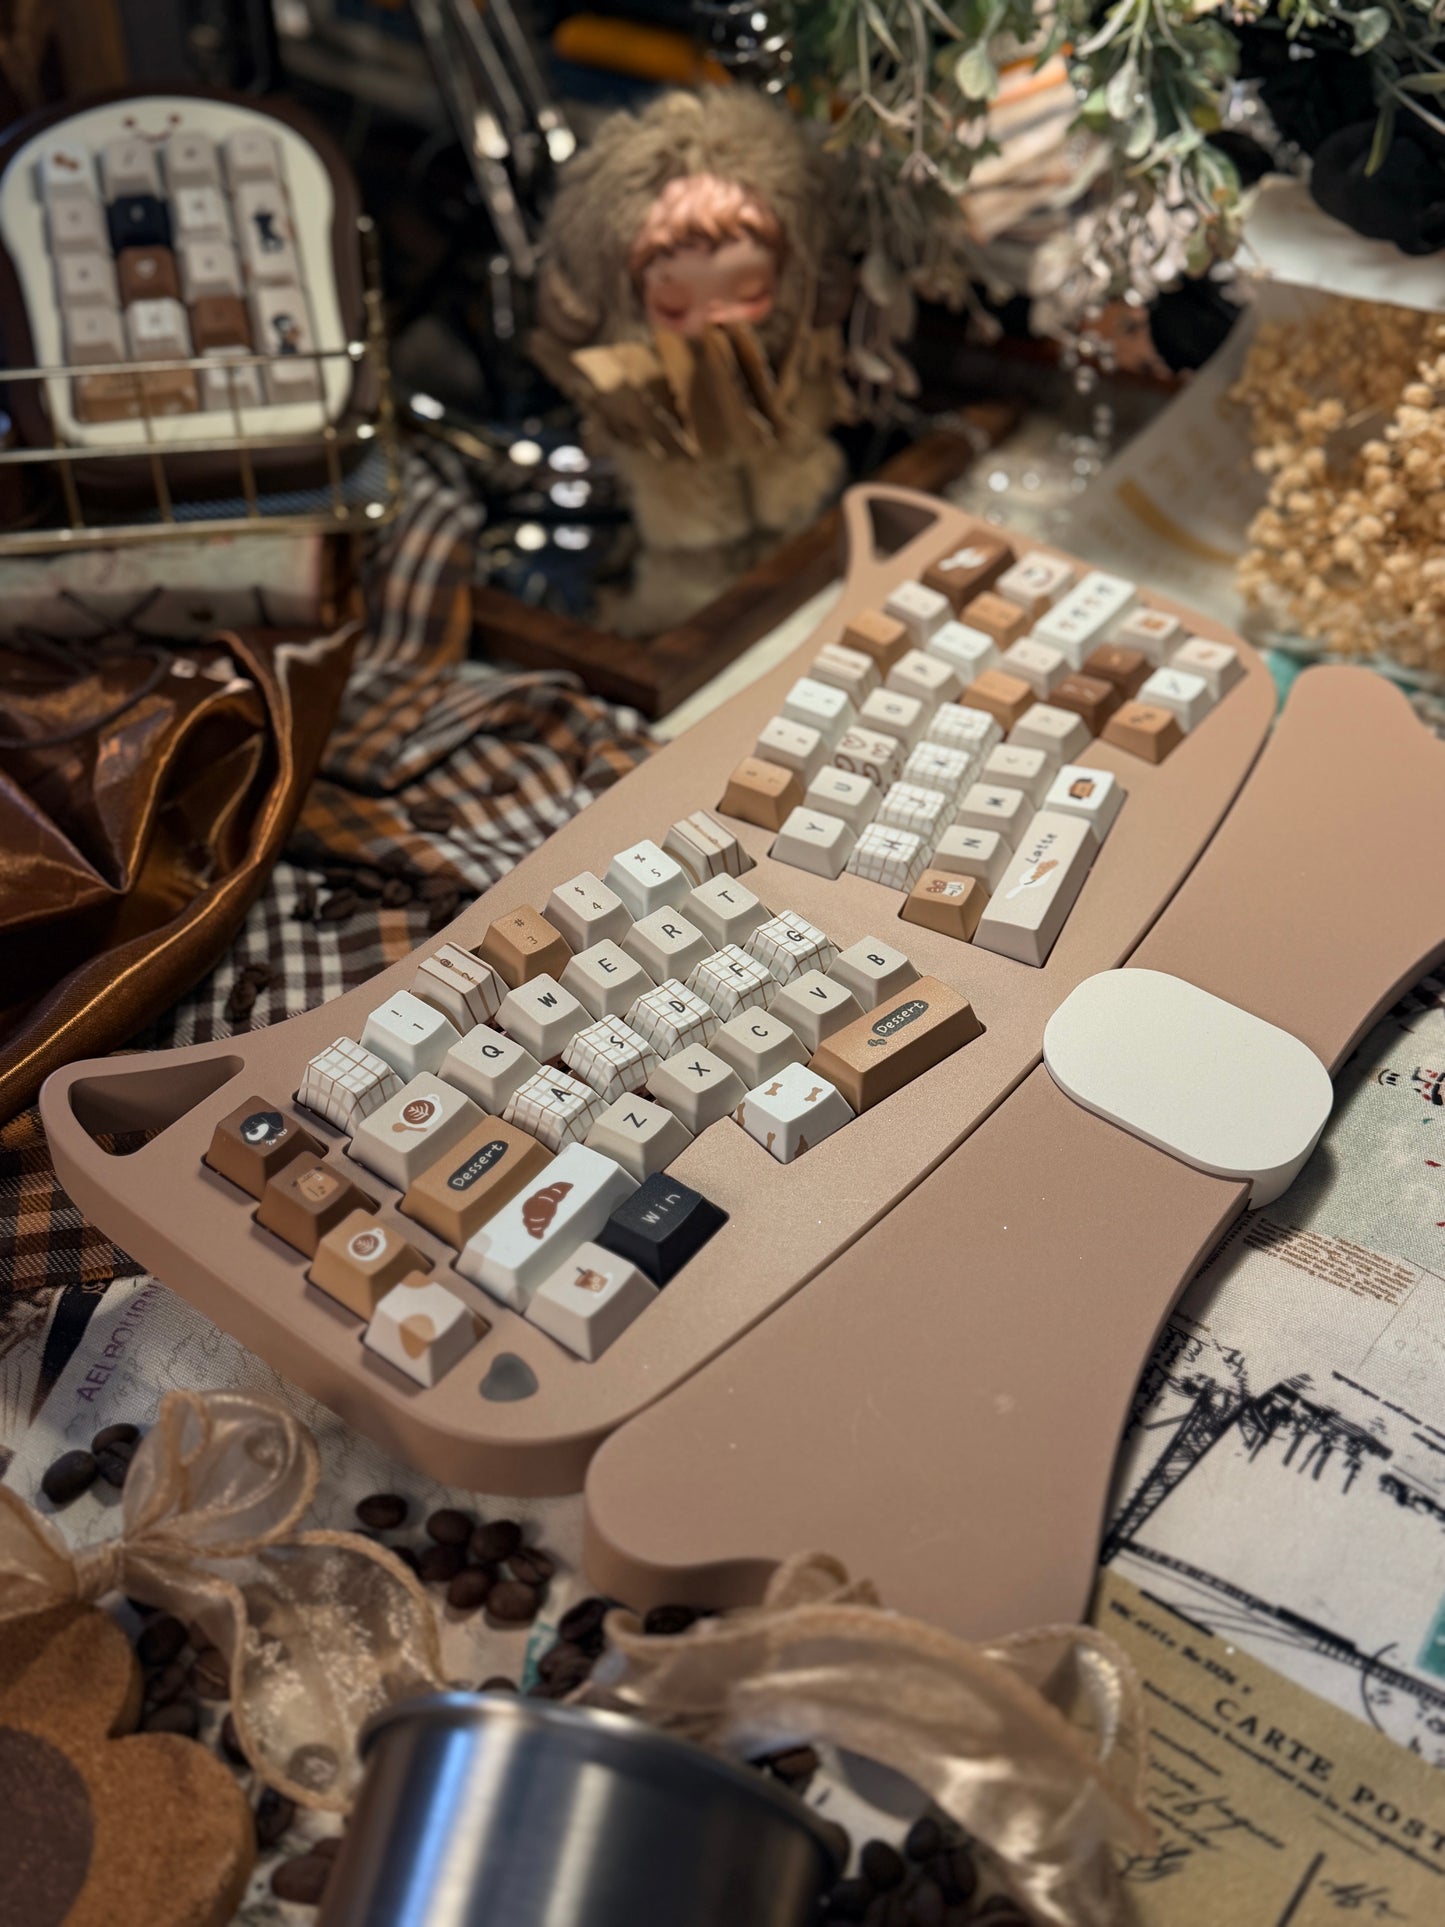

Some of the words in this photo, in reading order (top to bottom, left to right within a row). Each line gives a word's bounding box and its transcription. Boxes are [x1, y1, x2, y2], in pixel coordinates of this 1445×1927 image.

[834, 781, 852, 793] U
[805, 822, 824, 833] Y
[883, 838, 903, 851] H
[962, 837, 981, 849] N
[1025, 832, 1059, 865] Latte
[634, 852, 647, 864] %
[650, 868, 662, 878] 5
[717, 889, 736, 905] T
[592, 901, 603, 911] 4
[513, 917, 525, 929] #
[526, 934, 539, 945] 3
[661, 923, 683, 940] R
[786, 928, 805, 943] G
[598, 957, 619, 974] E
[866, 953, 886, 967] B
[461, 971, 475, 982] 2
[728, 961, 746, 978] F
[537, 991, 559, 1008] W
[809, 986, 828, 1000] V
[669, 999, 686, 1013] D
[875, 999, 925, 1034] Dessert
[750, 1024, 769, 1039] C
[609, 1034, 625, 1049] S
[481, 1044, 505, 1059] Q
[687, 1061, 711, 1077] X
[551, 1086, 572, 1102] A
[622, 1112, 648, 1129] Z
[452, 1141, 504, 1188] Dessert
[642, 1192, 683, 1225] Win
[1214, 1697, 1335, 1782] CARTE
